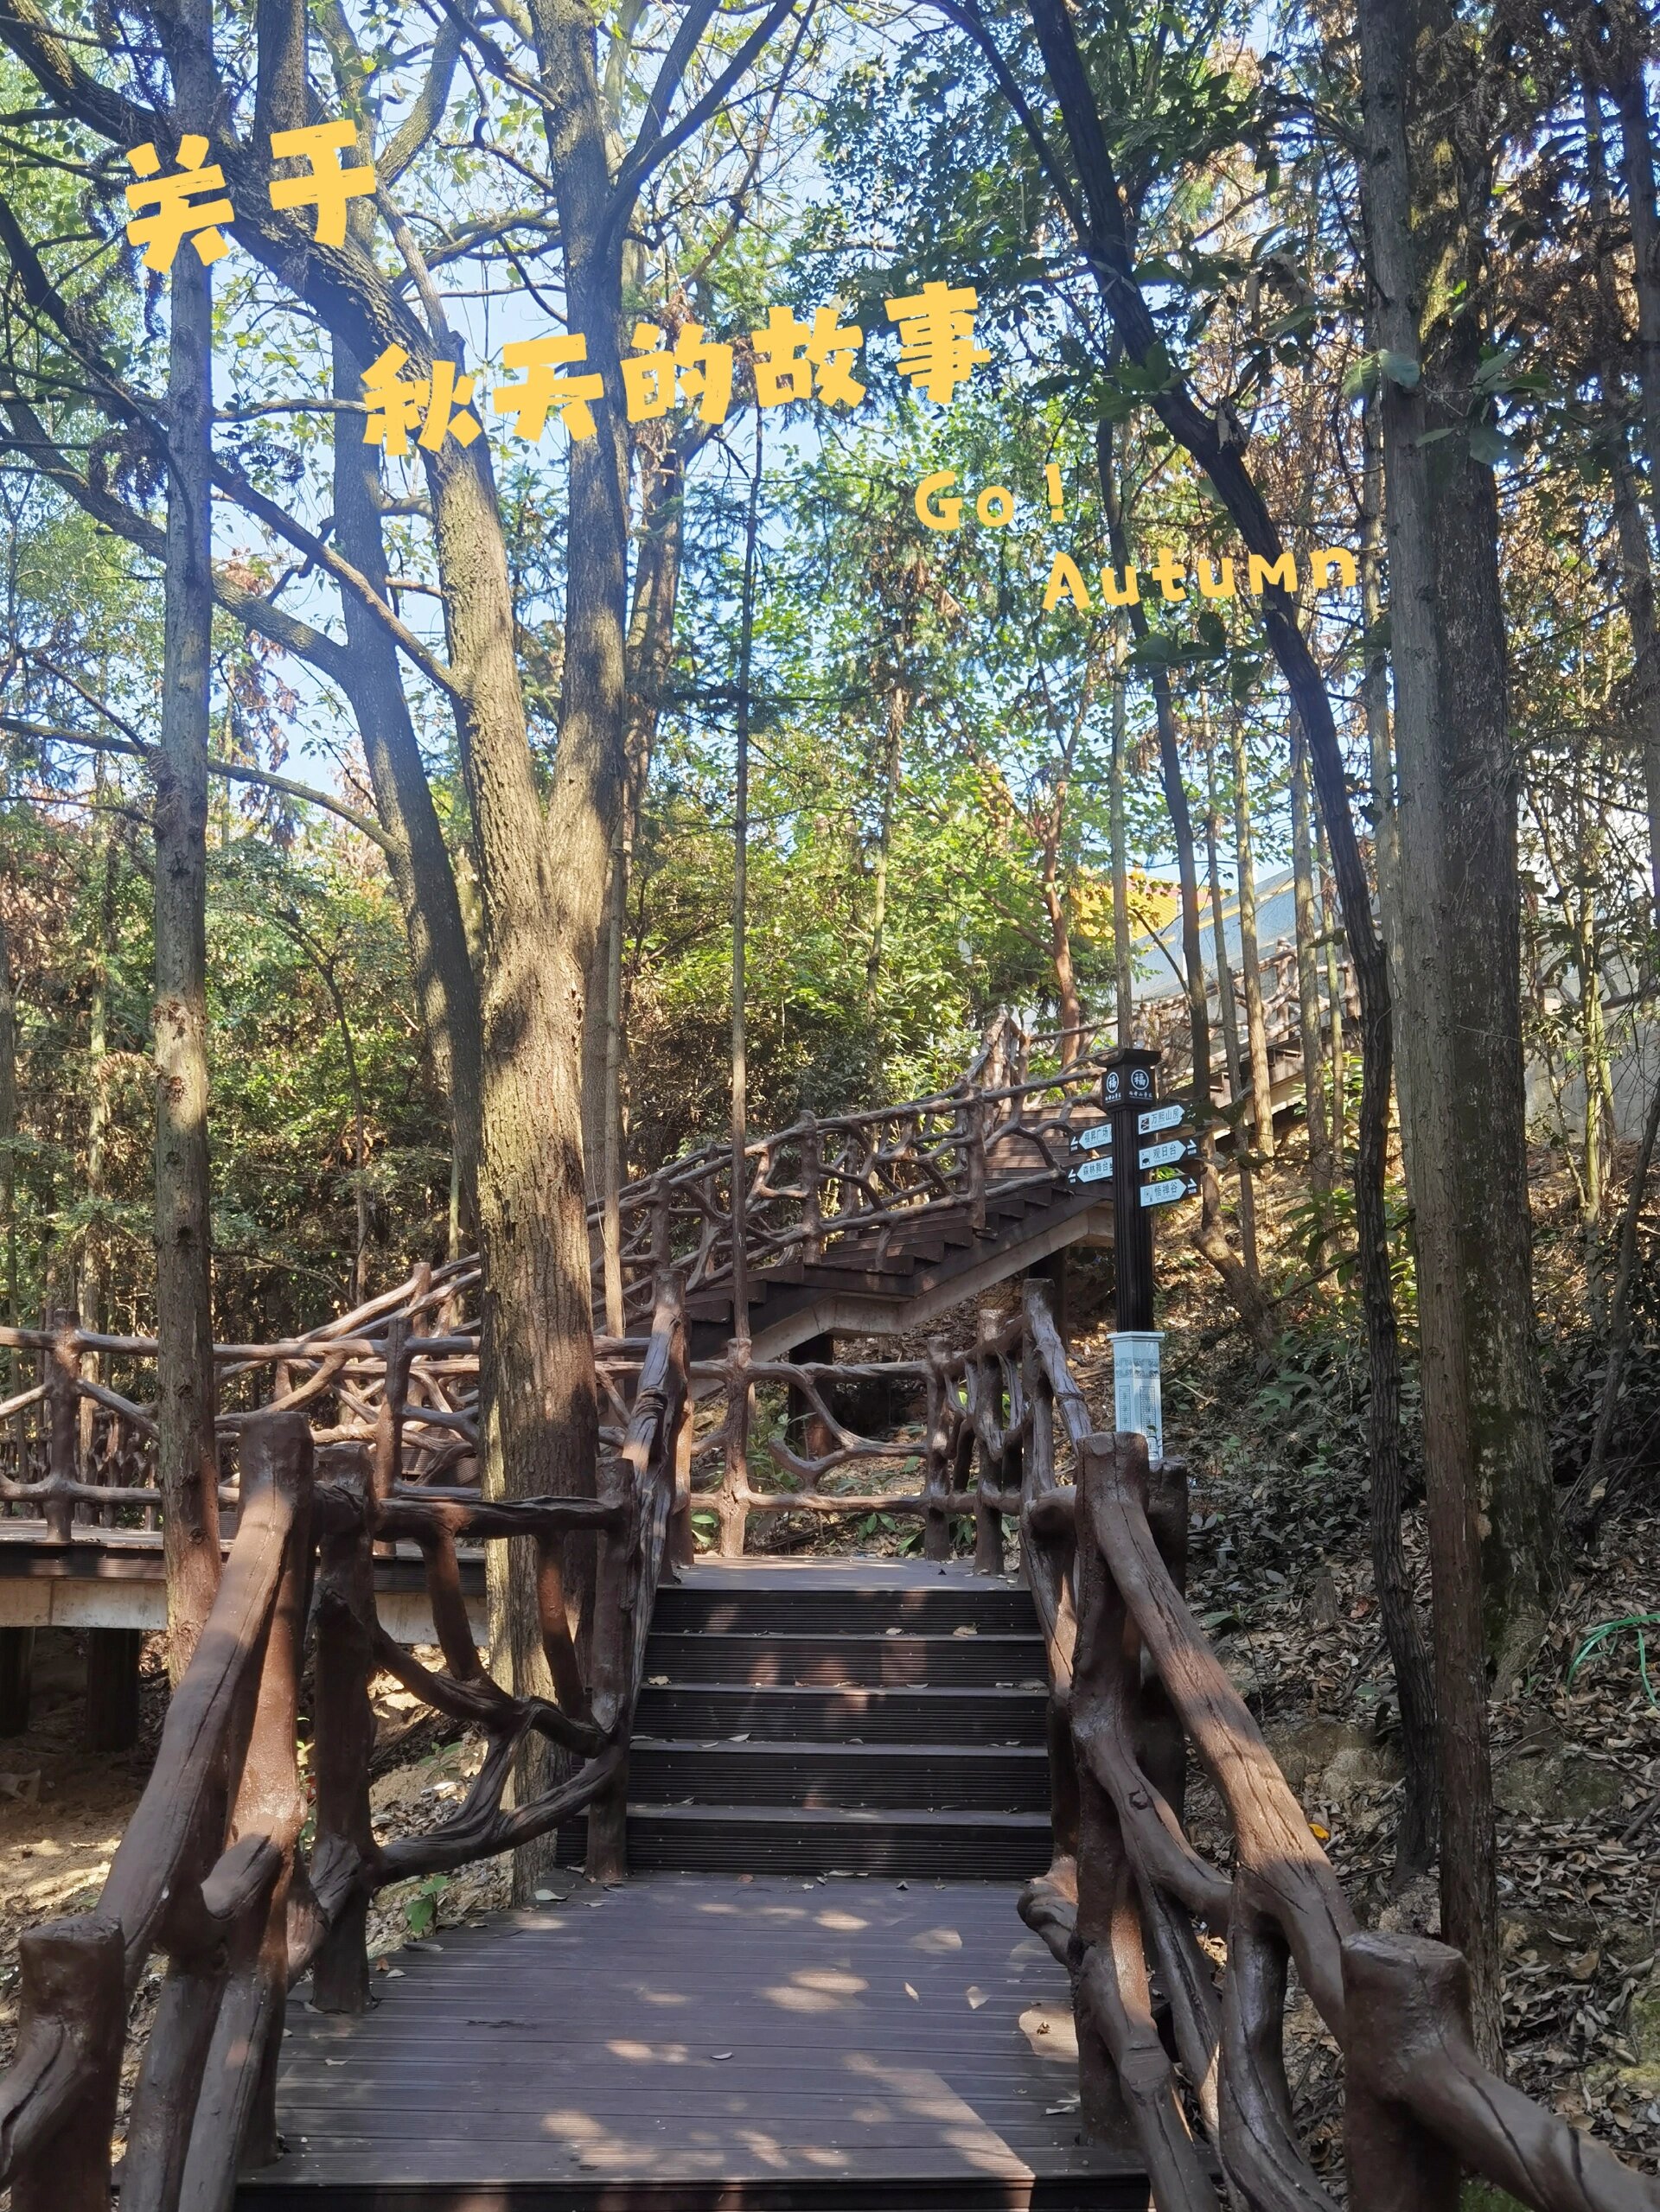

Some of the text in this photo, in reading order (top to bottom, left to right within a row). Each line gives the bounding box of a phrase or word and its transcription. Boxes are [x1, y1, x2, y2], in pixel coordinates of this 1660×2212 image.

[1152, 1144, 1177, 1159] 观日台
[1154, 1182, 1178, 1198] 悟禅谷
